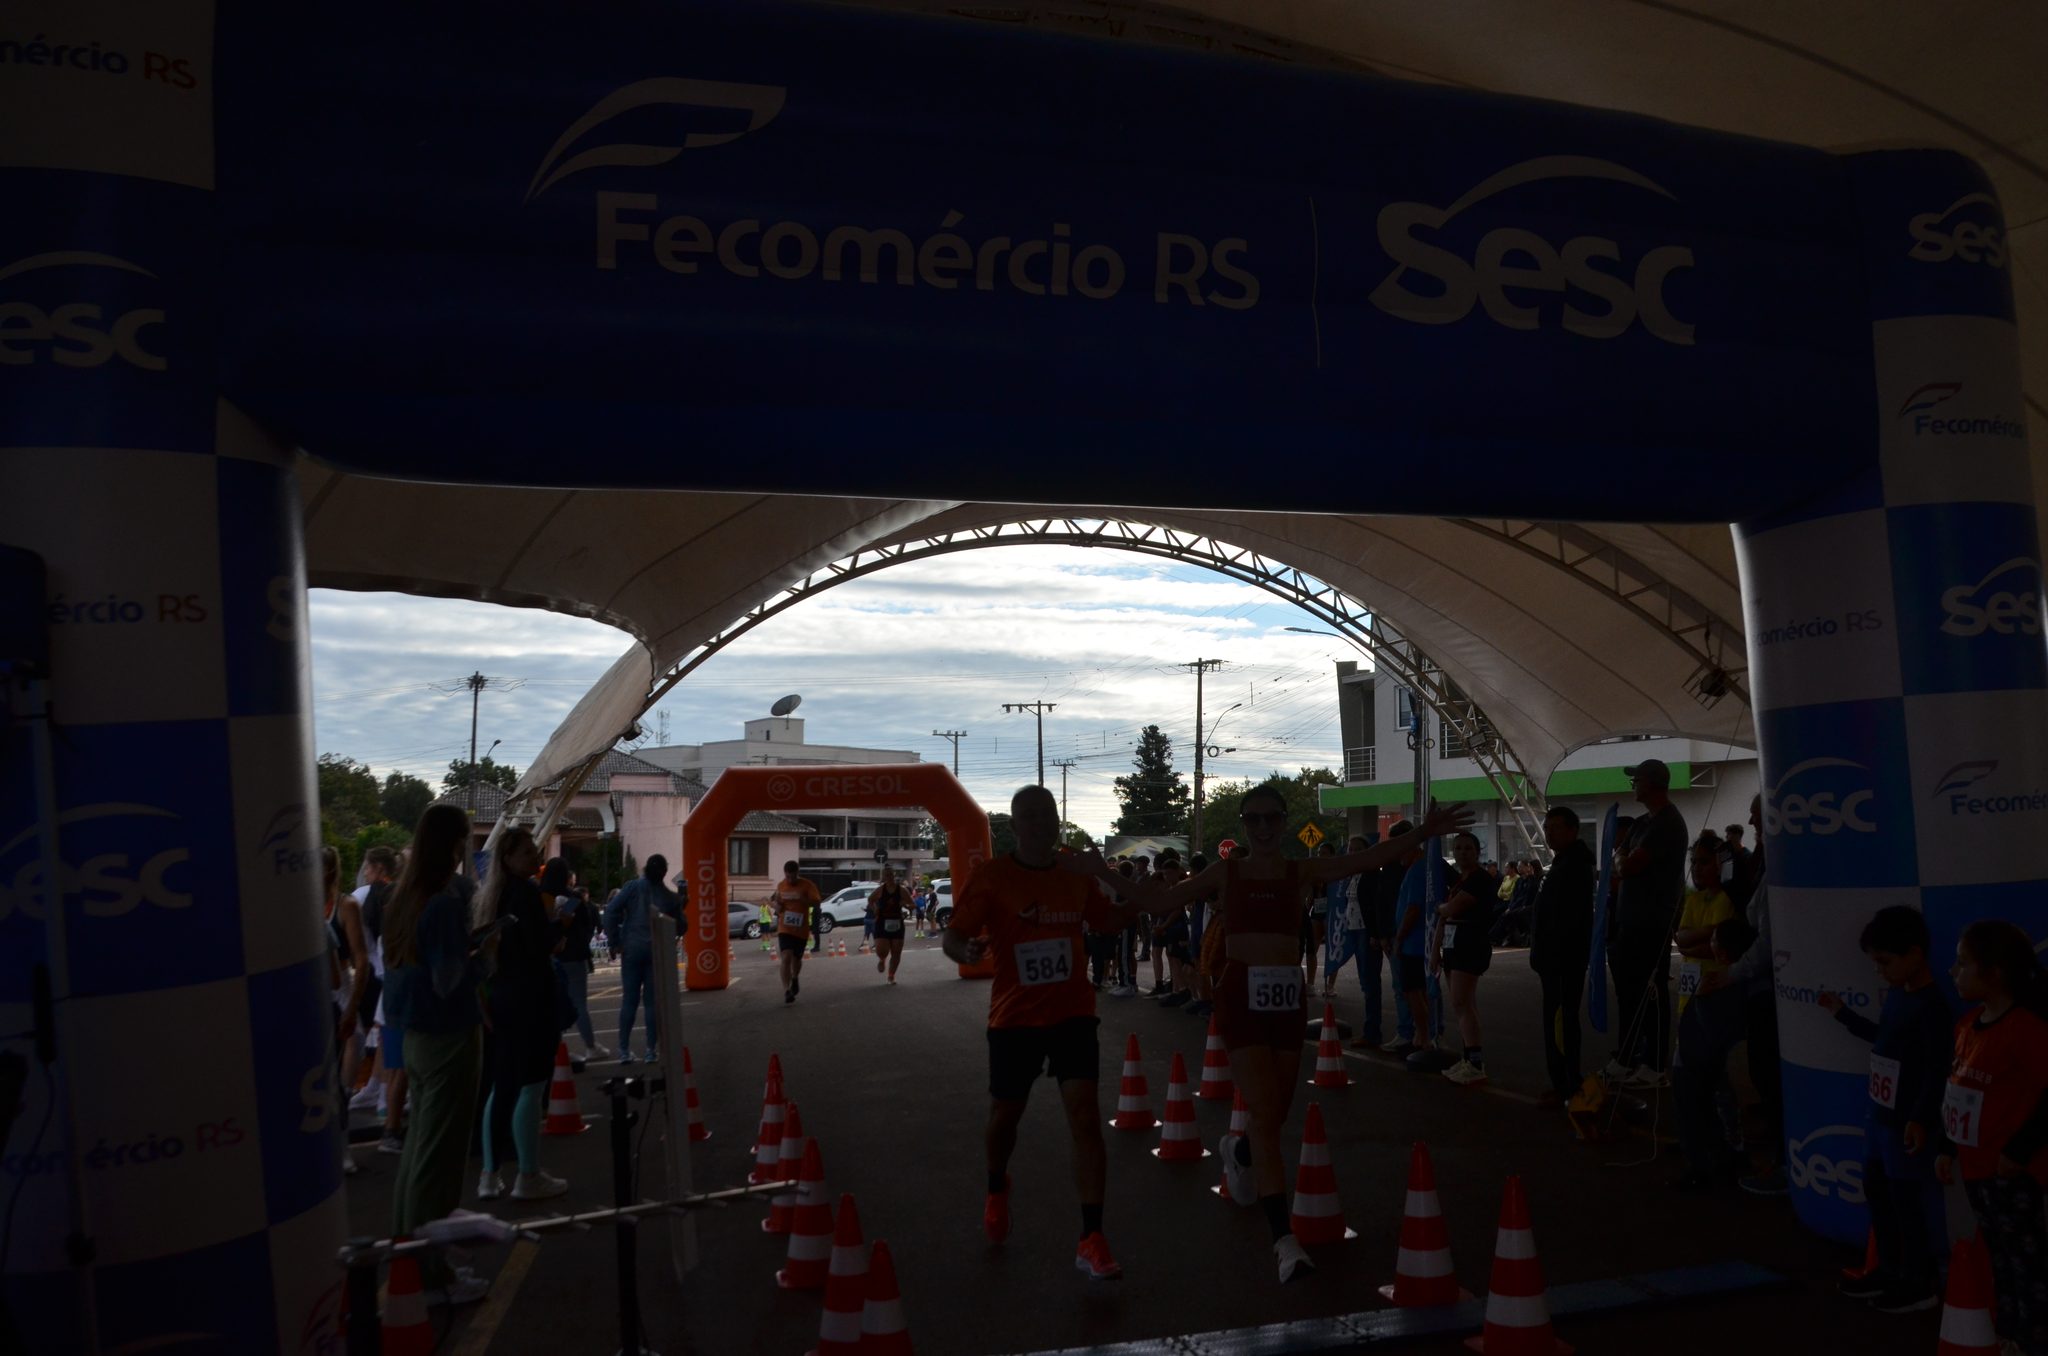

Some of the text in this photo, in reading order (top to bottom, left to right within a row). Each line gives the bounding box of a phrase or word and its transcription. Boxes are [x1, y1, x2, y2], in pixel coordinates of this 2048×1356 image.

[143, 51, 197, 90] RS
[595, 190, 1261, 311] Fecomércio RS
[1367, 200, 1696, 345] Sesc
[158, 594, 208, 623] RS
[1846, 609, 1882, 633] RS
[805, 774, 911, 797] CRESOL
[699, 852, 716, 942] CRESOL
[1025, 954, 1069, 981] 584
[1256, 983, 1297, 1007] 580
[198, 1118, 243, 1152] RS
[1788, 1137, 1868, 1204] Ses
